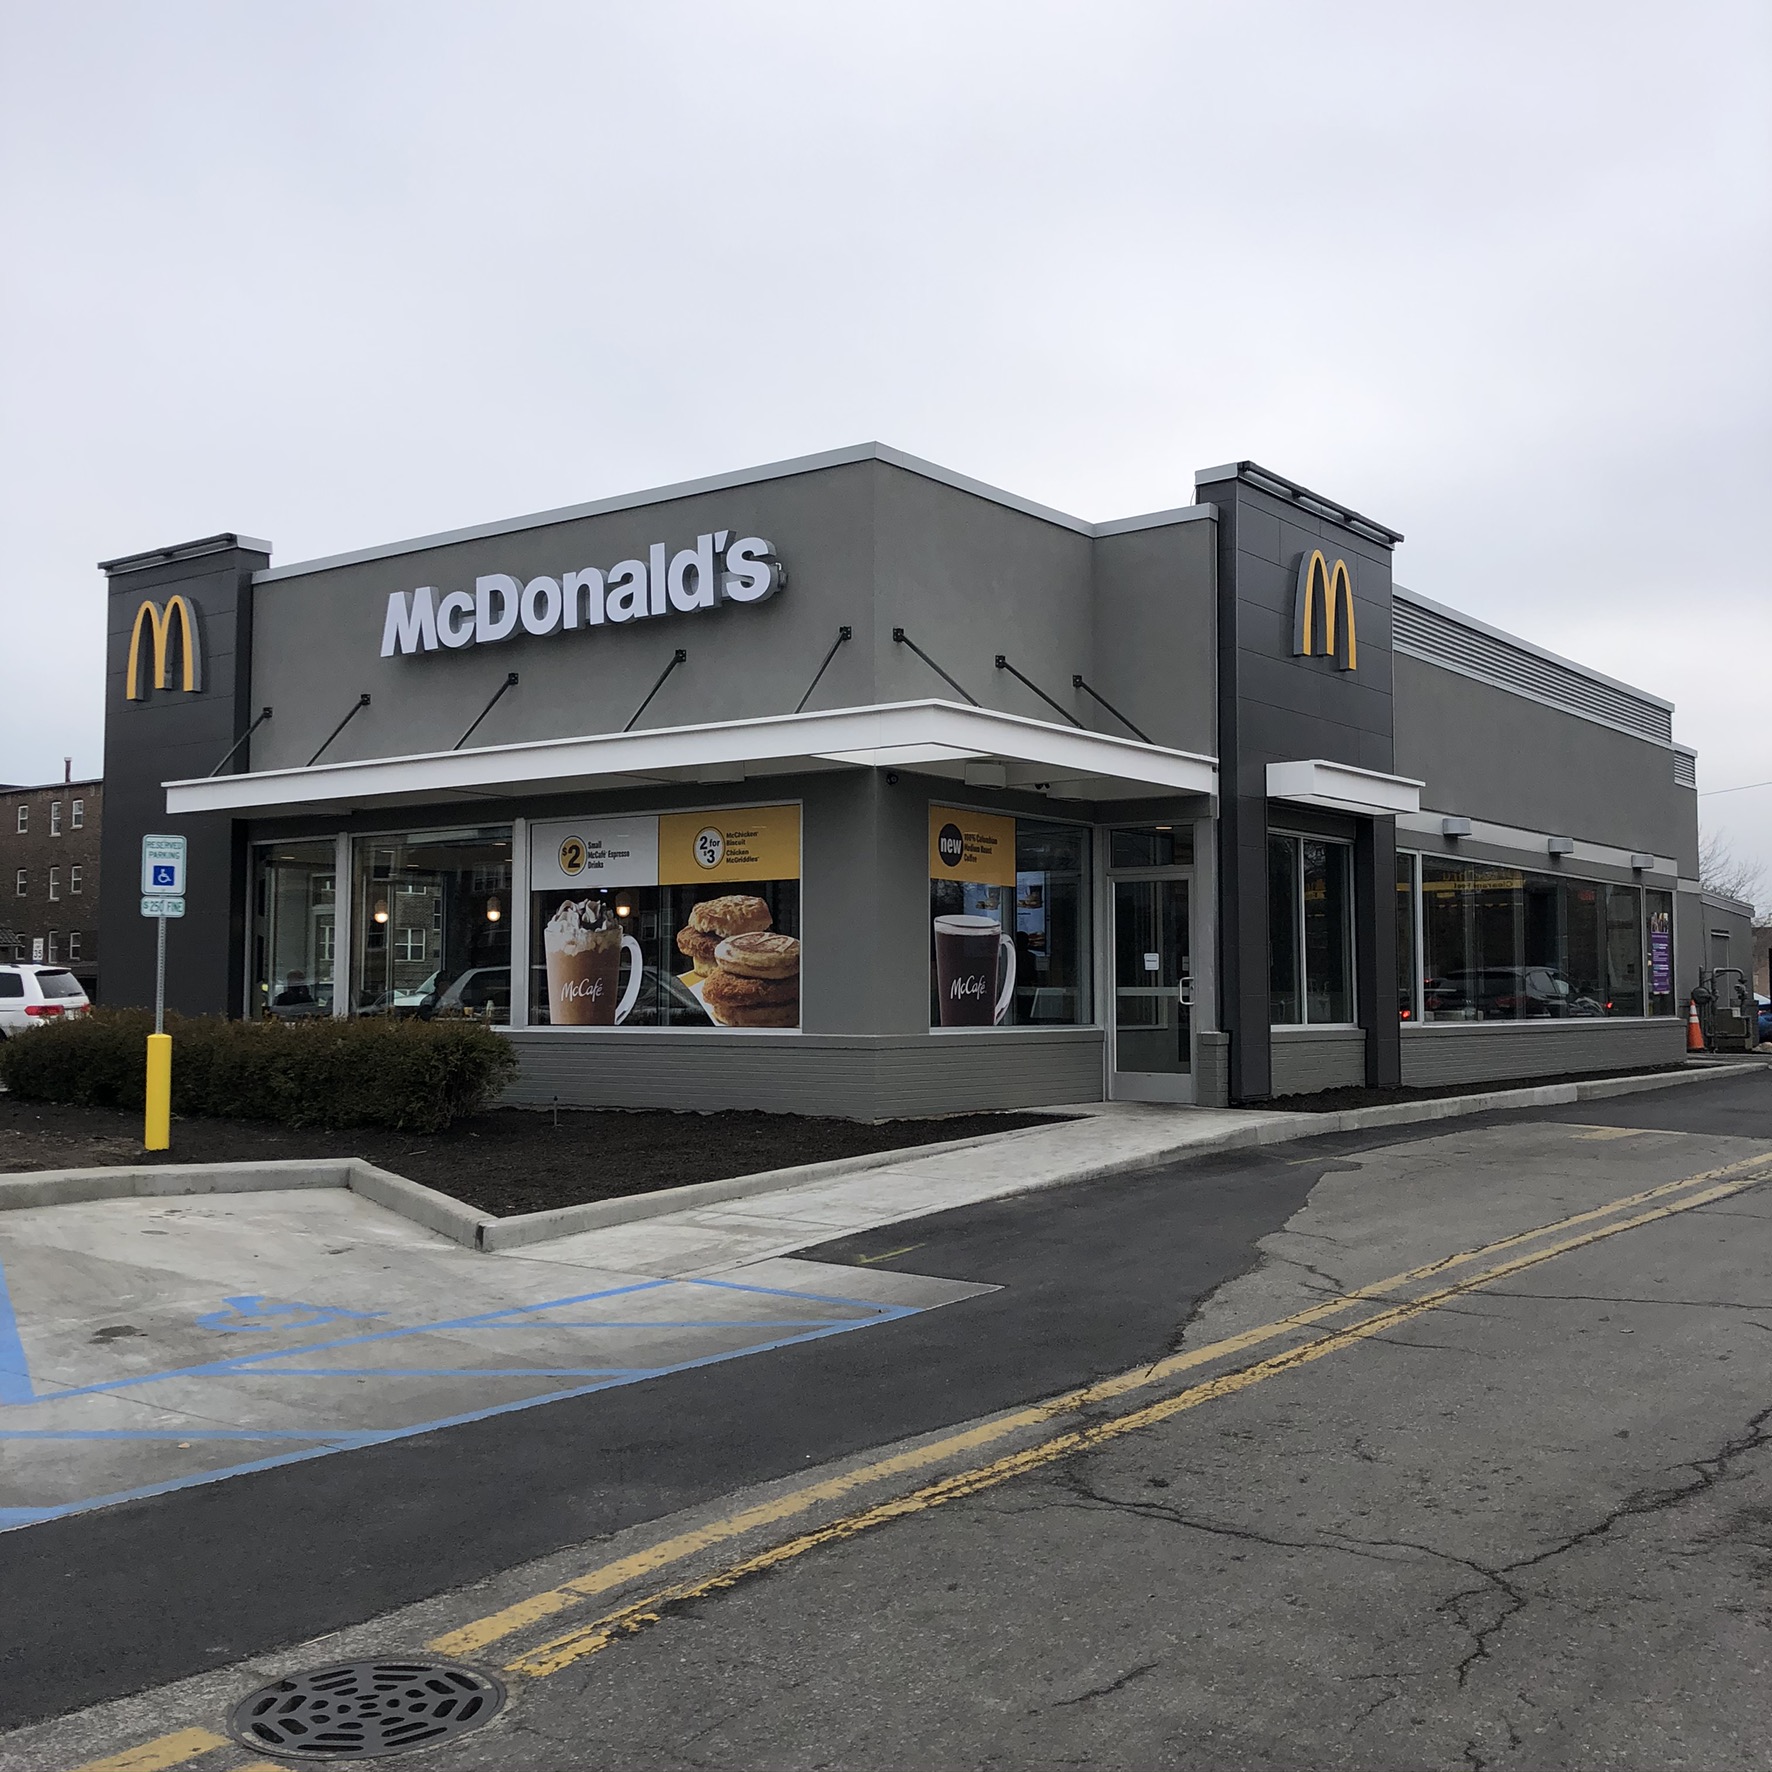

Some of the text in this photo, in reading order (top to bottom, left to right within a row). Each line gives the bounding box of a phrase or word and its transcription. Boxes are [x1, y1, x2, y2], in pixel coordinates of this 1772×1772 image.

[380, 529, 775, 659] McDonald's
[147, 841, 183, 850] RESERVED
[587, 841, 602, 849] Small
[699, 836, 721, 850] 2 for
[940, 837, 962, 854] new
[148, 851, 180, 859] PARKING
[562, 844, 581, 868] $2
[608, 850, 630, 860] Espresso
[703, 849, 716, 863] $3
[587, 861, 604, 869] Drinks
[166, 901, 183, 912] FINE
[560, 977, 604, 1002] McCafé
[950, 974, 987, 1001] McCafé
